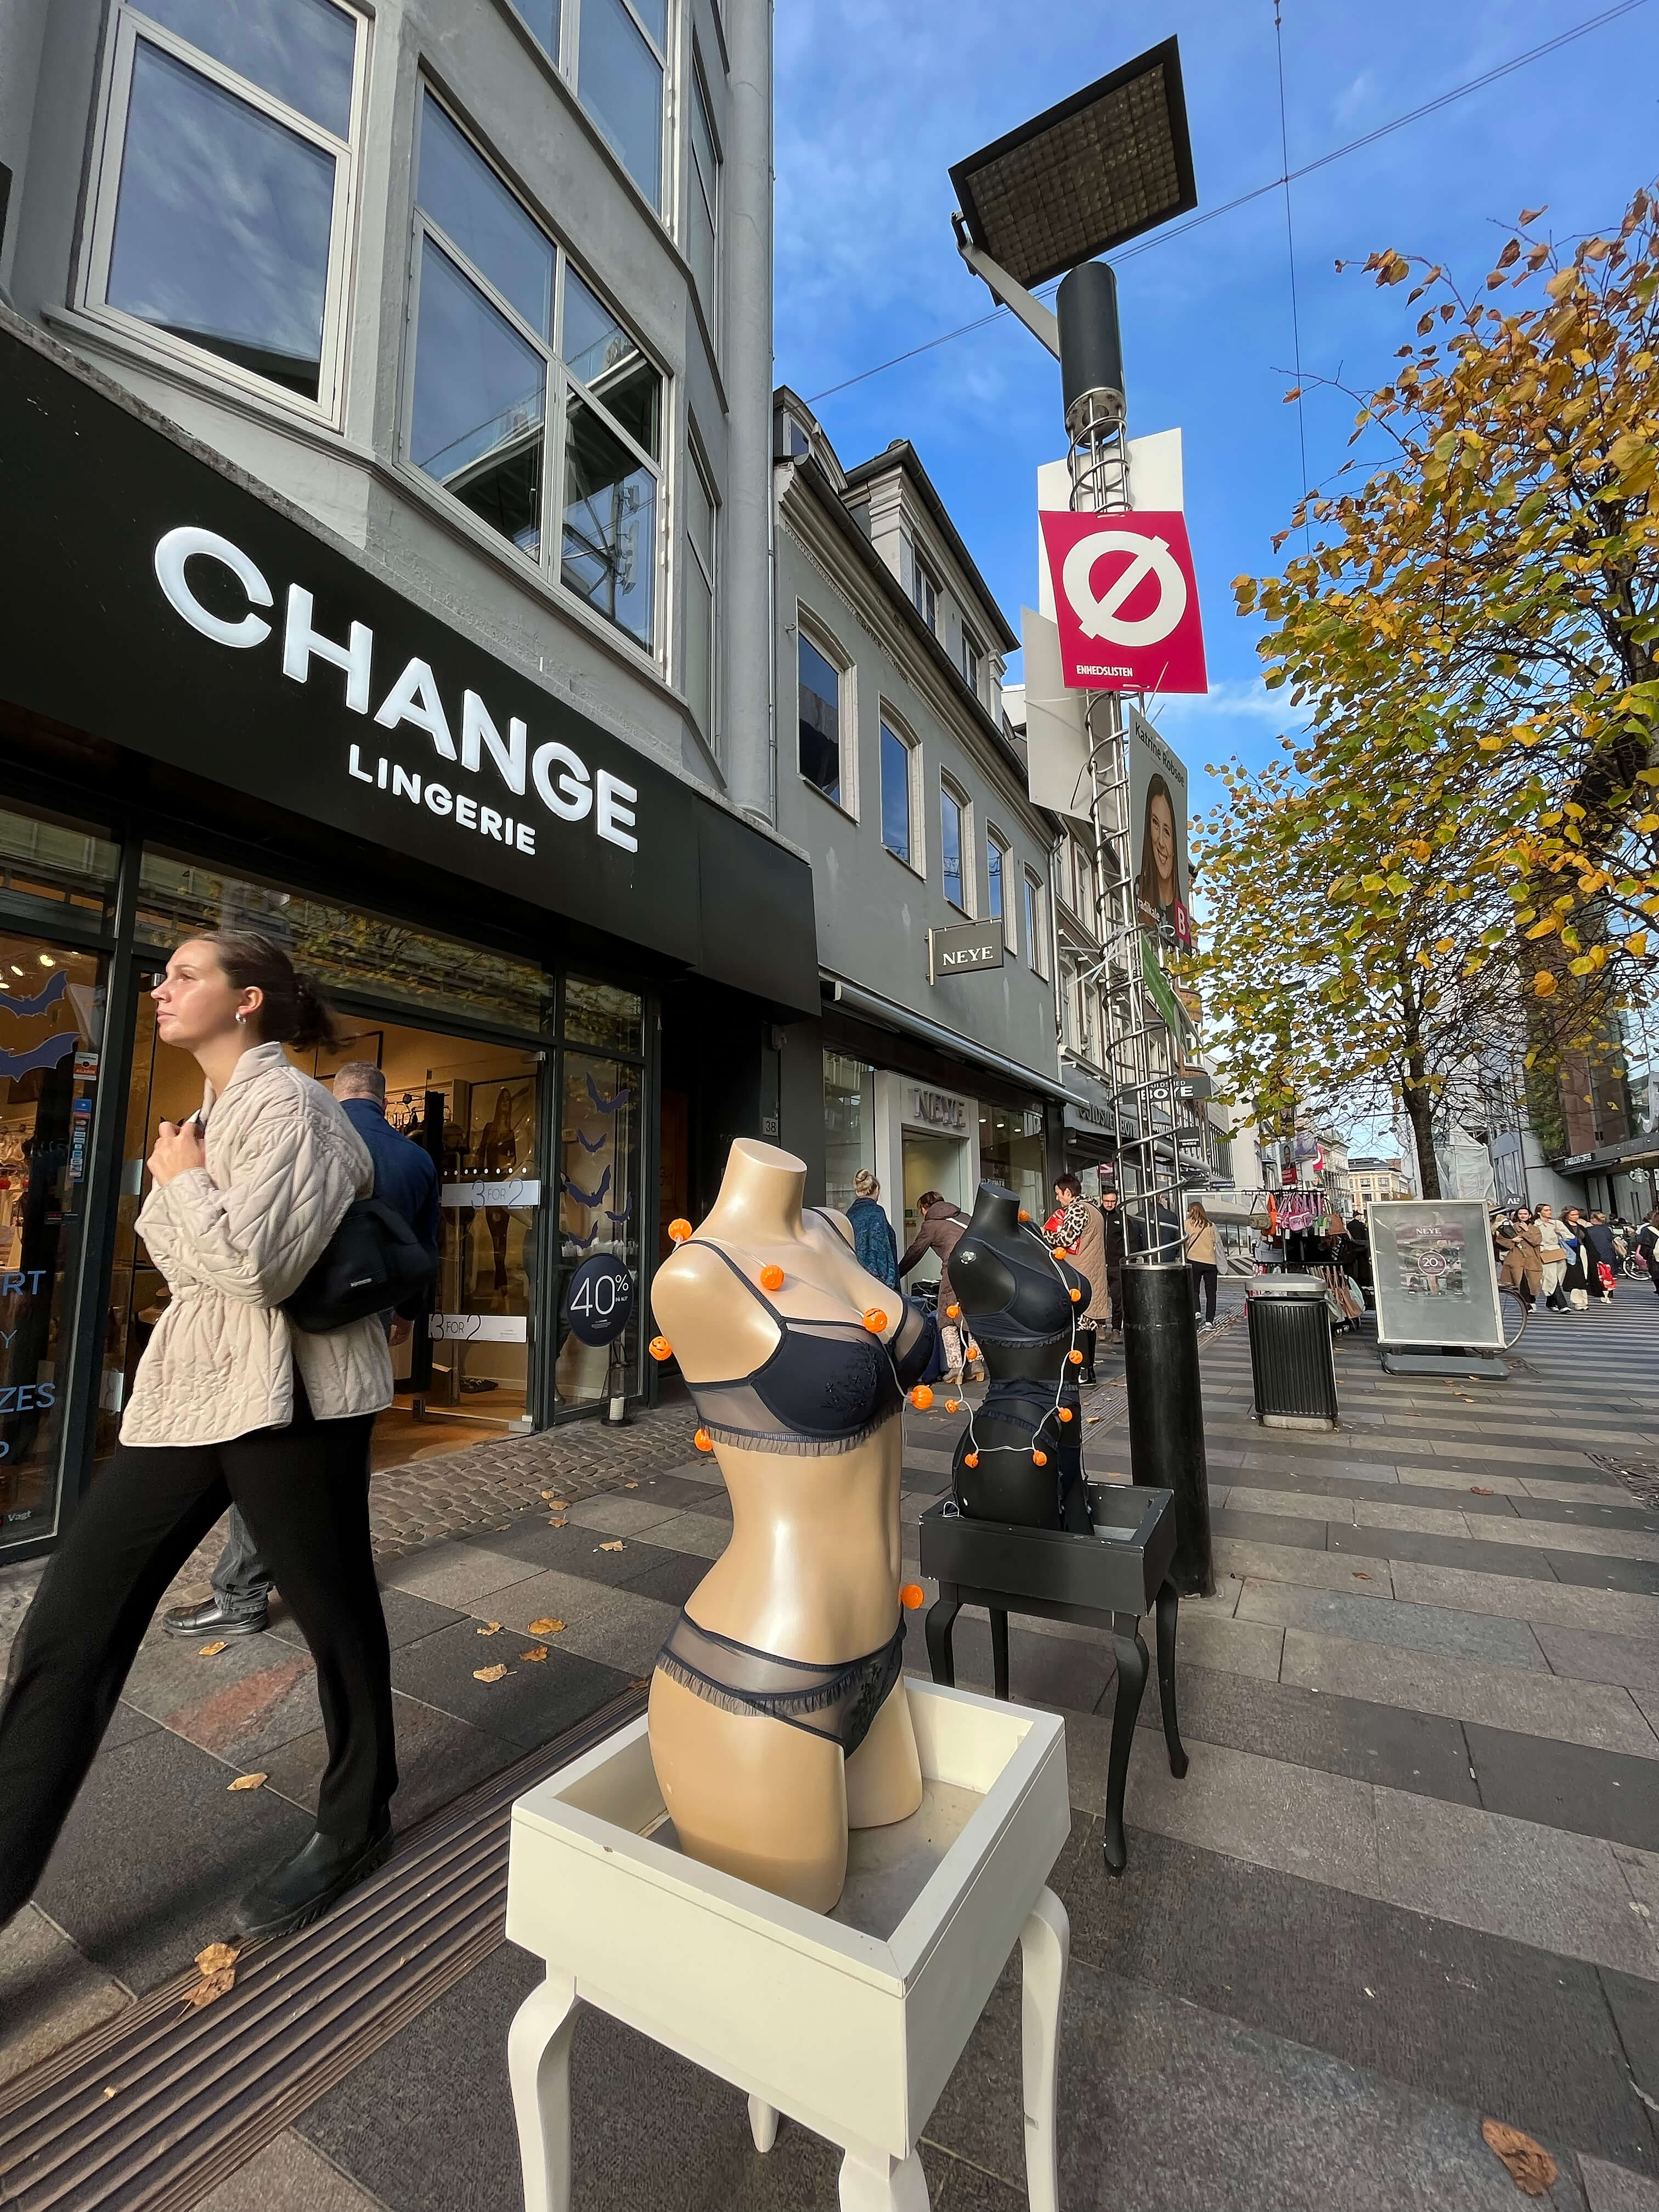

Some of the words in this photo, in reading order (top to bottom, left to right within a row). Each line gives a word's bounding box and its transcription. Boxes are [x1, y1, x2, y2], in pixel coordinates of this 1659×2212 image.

[1076, 664, 1133, 677] ENHEDSLISTEN
[155, 526, 639, 854] CHANGE
[1135, 721, 1161, 761] Katrine
[1162, 751, 1185, 788] Robsøe
[347, 743, 537, 856] LINGERIE
[1137, 898, 1160, 922] radikale
[1177, 906, 1186, 935] B
[943, 946, 994, 966] NEYE
[1141, 1085, 1194, 1101] BOYE
[913, 1088, 966, 1128] NEYE
[766, 1121, 776, 1133] 38
[471, 1180, 485, 1209] 3
[487, 1188, 506, 1200] FOR
[508, 1178, 524, 1209] 2
[571, 1274, 629, 1317] 40%
[430, 1313, 444, 1341] 3
[446, 1321, 465, 1334] FOR
[466, 1314, 481, 1340] 2
